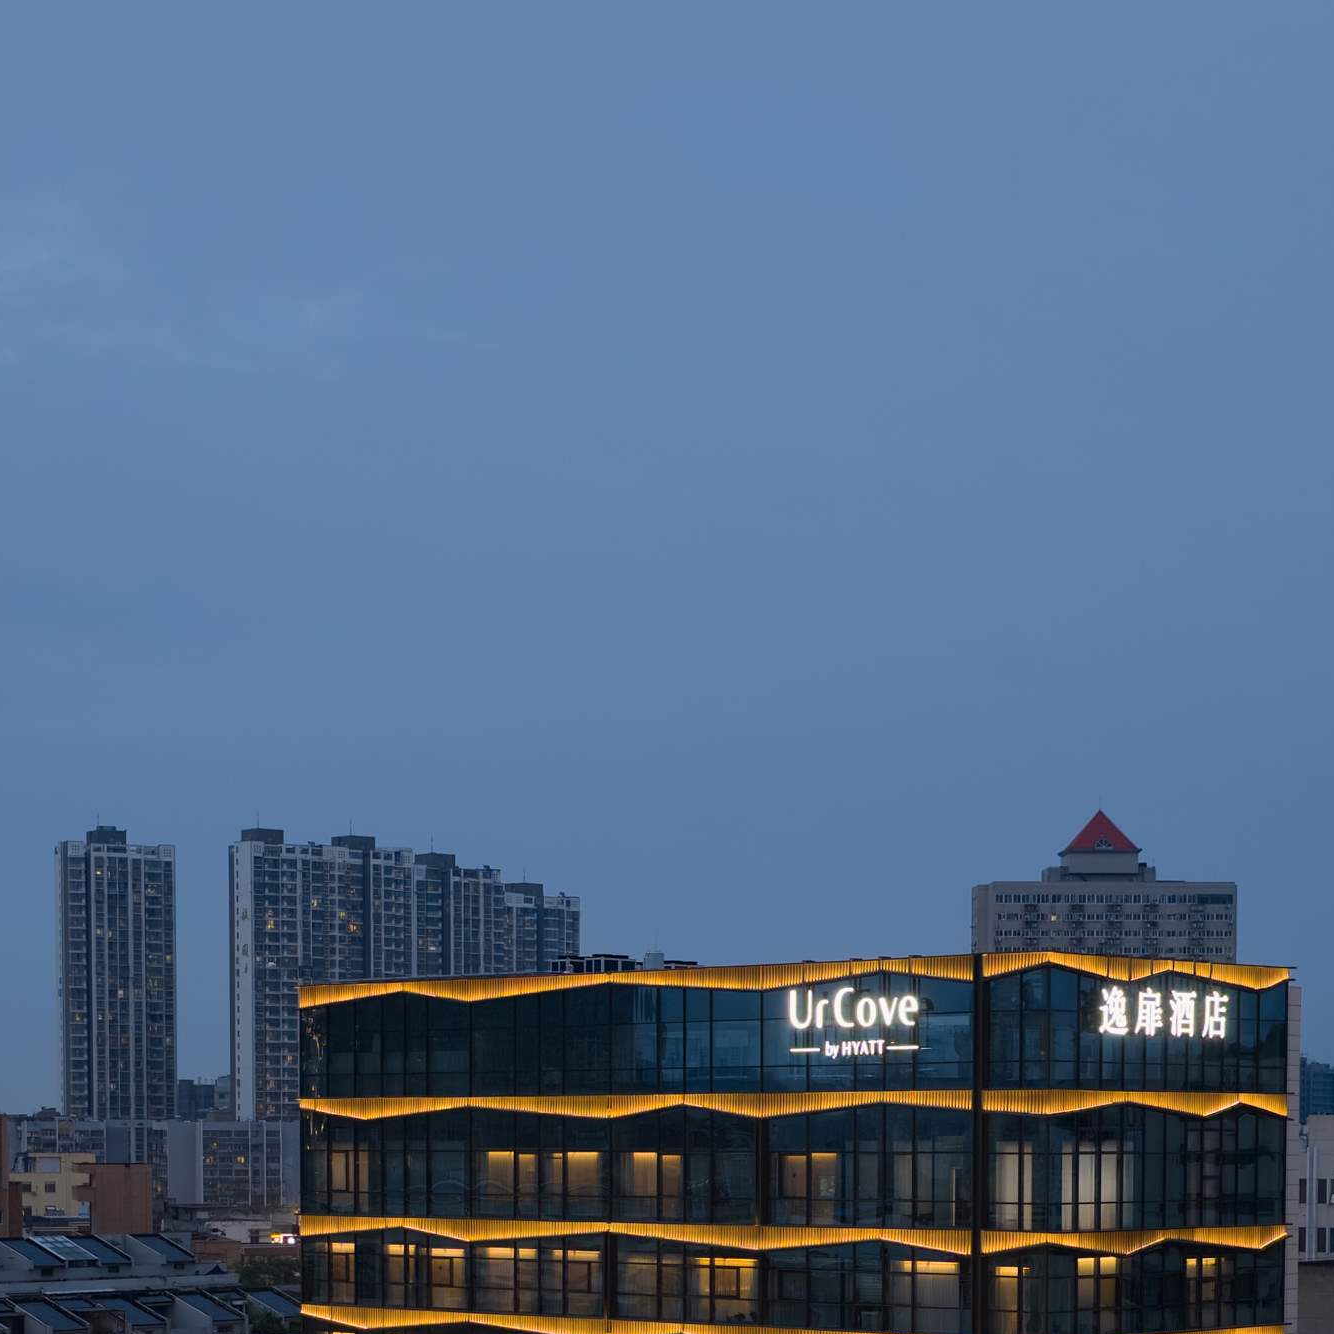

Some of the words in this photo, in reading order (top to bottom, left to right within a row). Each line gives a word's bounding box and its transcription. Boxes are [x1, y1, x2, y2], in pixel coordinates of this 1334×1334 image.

[788, 987, 919, 1030] UrCove
[1098, 985, 1230, 1039] 逸扉酒店
[824, 1040, 840, 1060] by
[841, 1039, 886, 1056] HYATT
